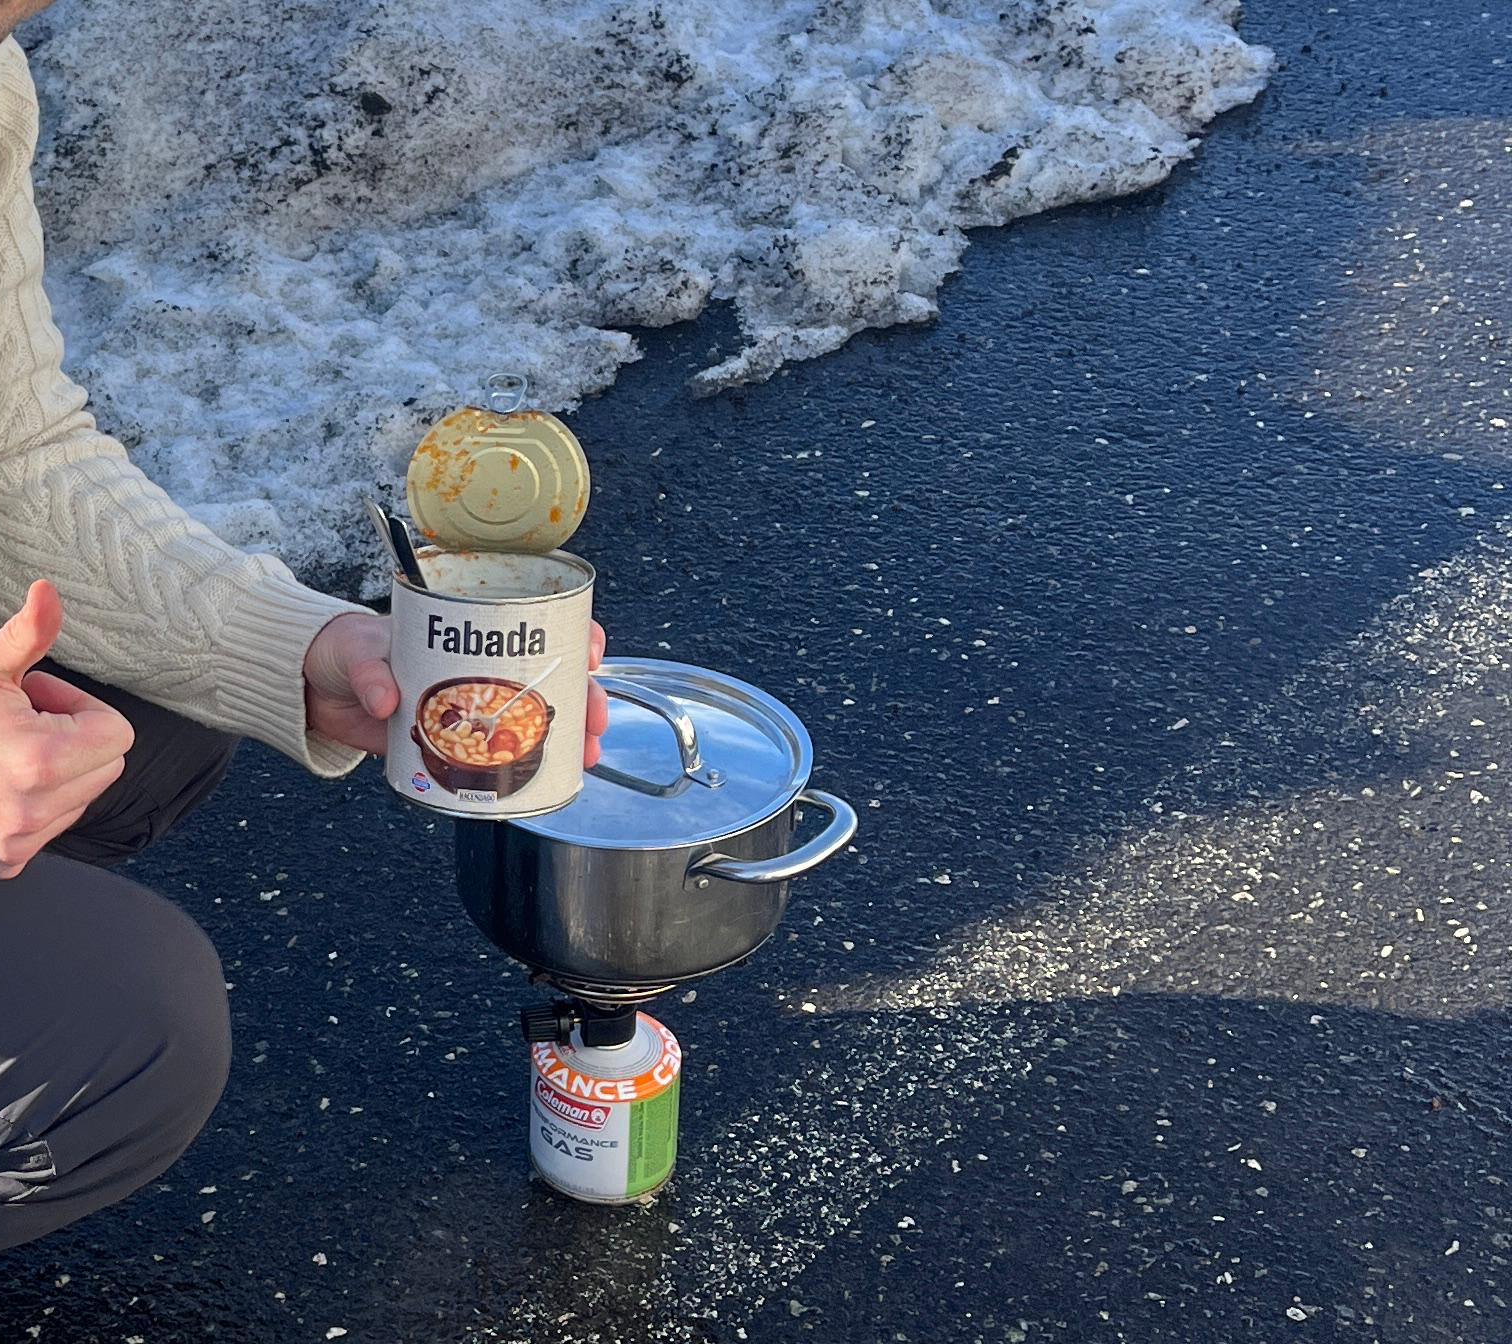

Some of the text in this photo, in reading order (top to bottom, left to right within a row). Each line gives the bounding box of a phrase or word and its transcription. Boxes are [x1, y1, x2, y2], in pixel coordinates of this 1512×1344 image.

[428, 614, 546, 658] Fabada
[533, 1027, 682, 1102] MANCE C300
[538, 1080, 590, 1121] Coleman
[541, 1126, 594, 1162] GAS
